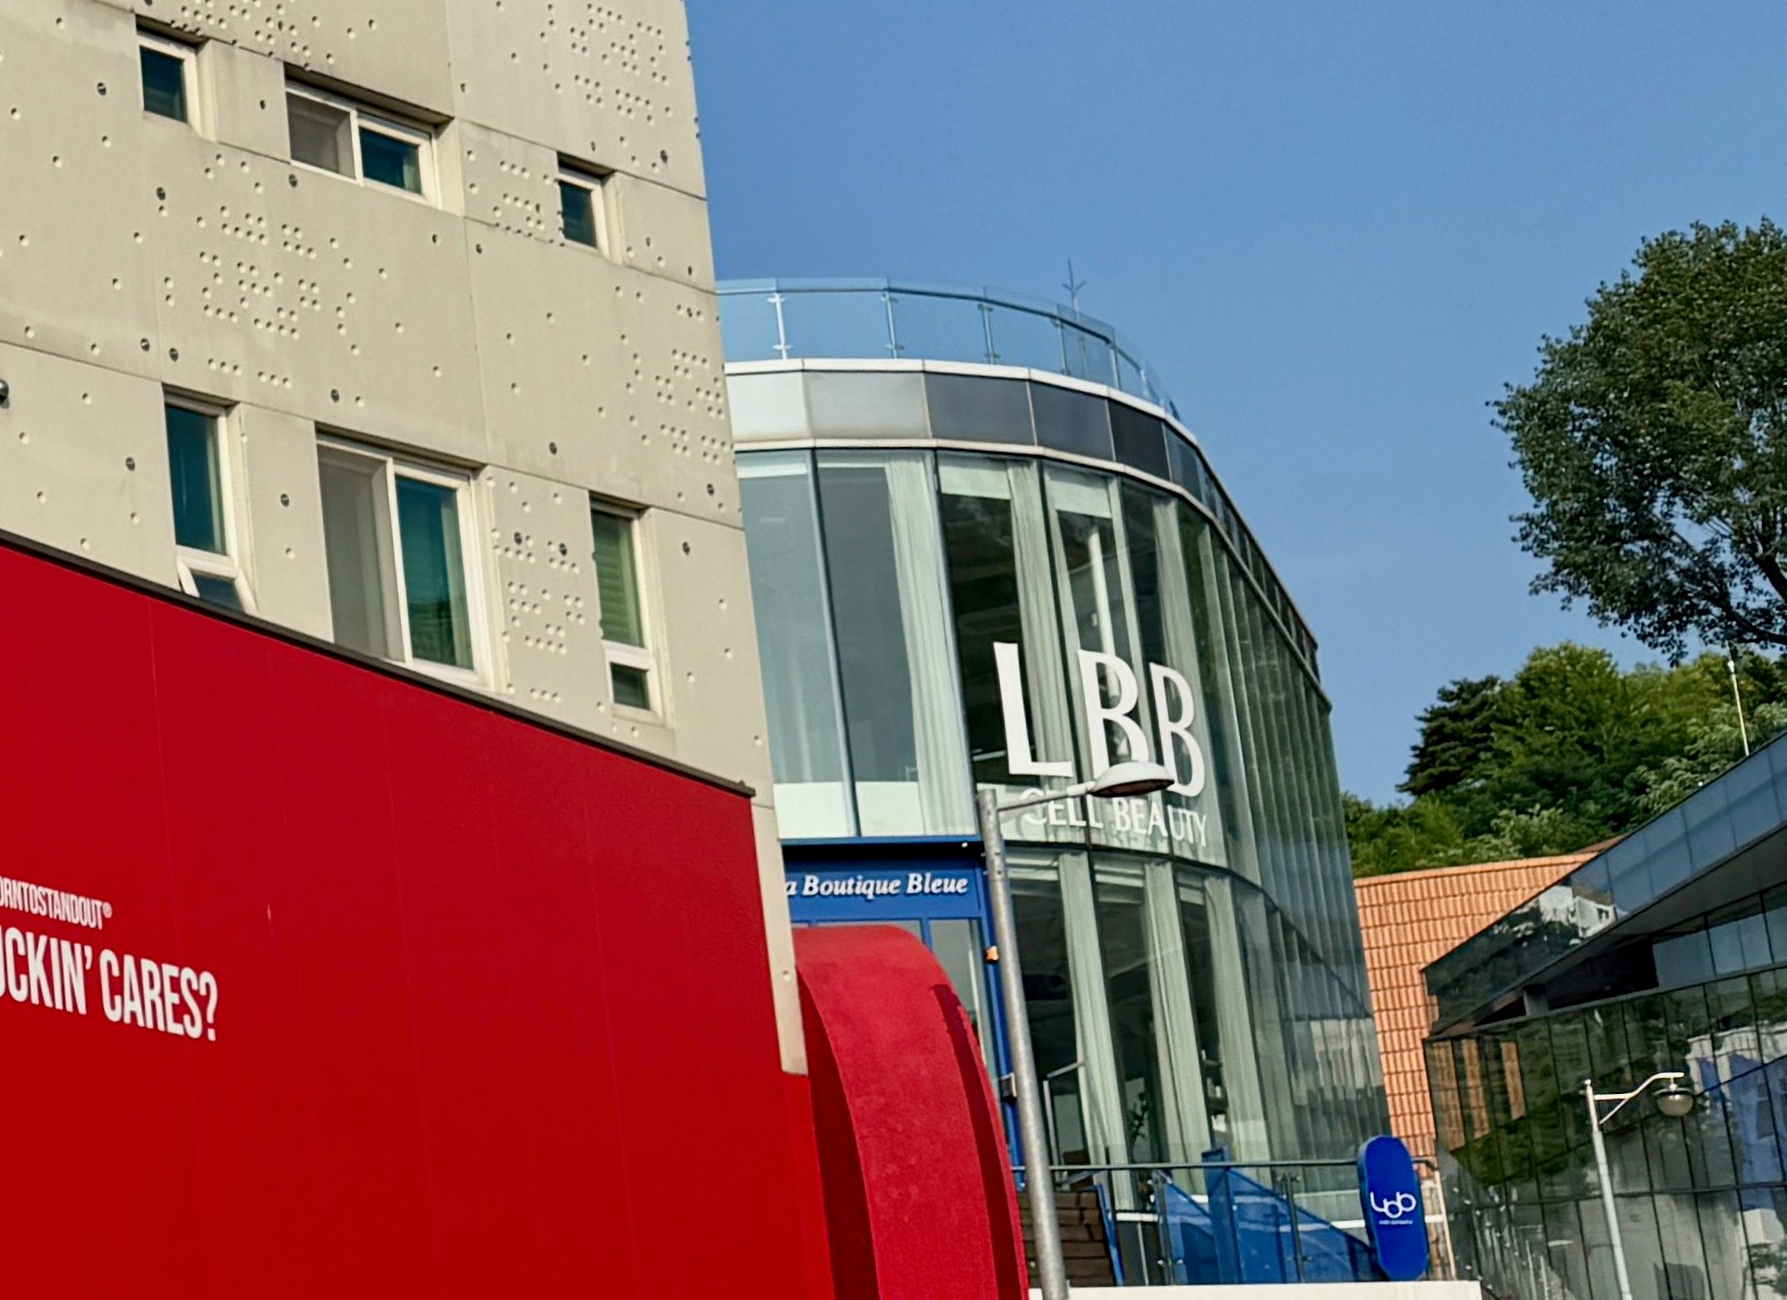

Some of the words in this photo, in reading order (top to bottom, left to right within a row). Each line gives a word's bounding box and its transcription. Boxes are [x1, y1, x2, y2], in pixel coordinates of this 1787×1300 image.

[993, 642, 1205, 797] LBB
[1112, 796, 1207, 847] BEAUTY
[802, 875, 901, 900] Boutique
[907, 873, 968, 894] Bleue
[99, 948, 219, 1042] CARES?
